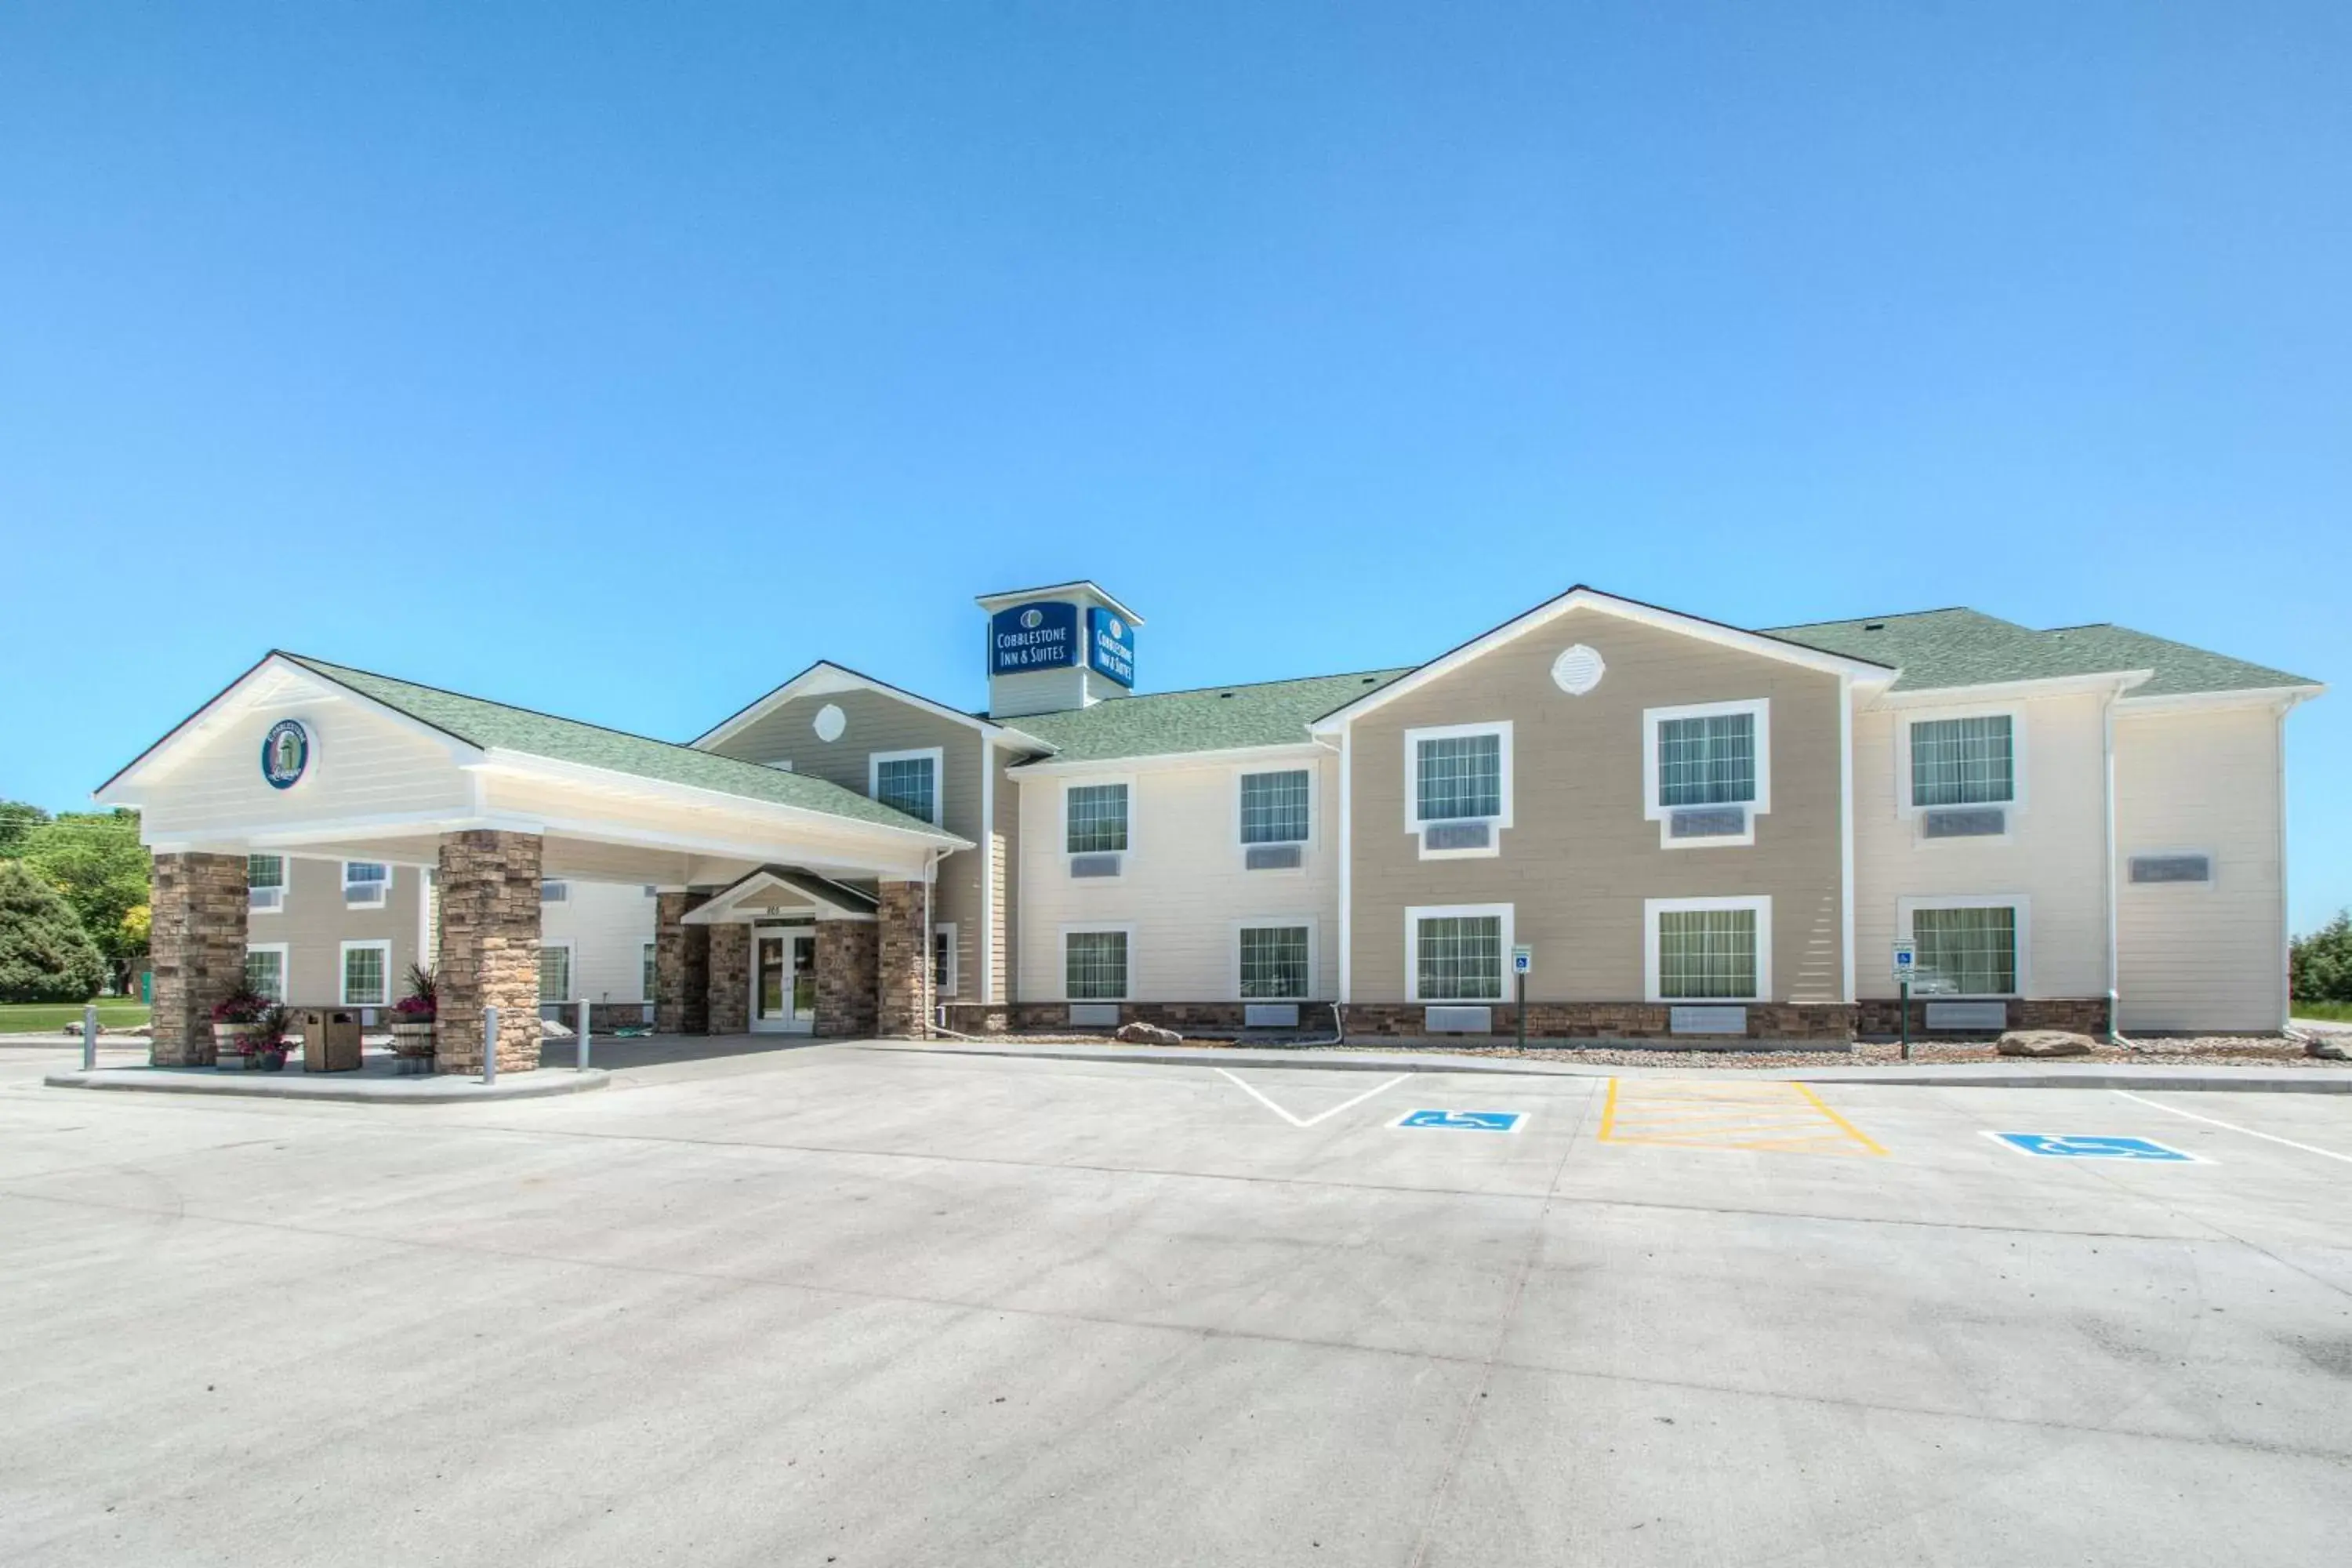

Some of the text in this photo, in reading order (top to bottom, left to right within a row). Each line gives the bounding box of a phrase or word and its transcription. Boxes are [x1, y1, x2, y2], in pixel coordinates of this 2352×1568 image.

[997, 627, 1066, 648] COBBLESTONE
[1000, 646, 1065, 667] INN & SUITES
